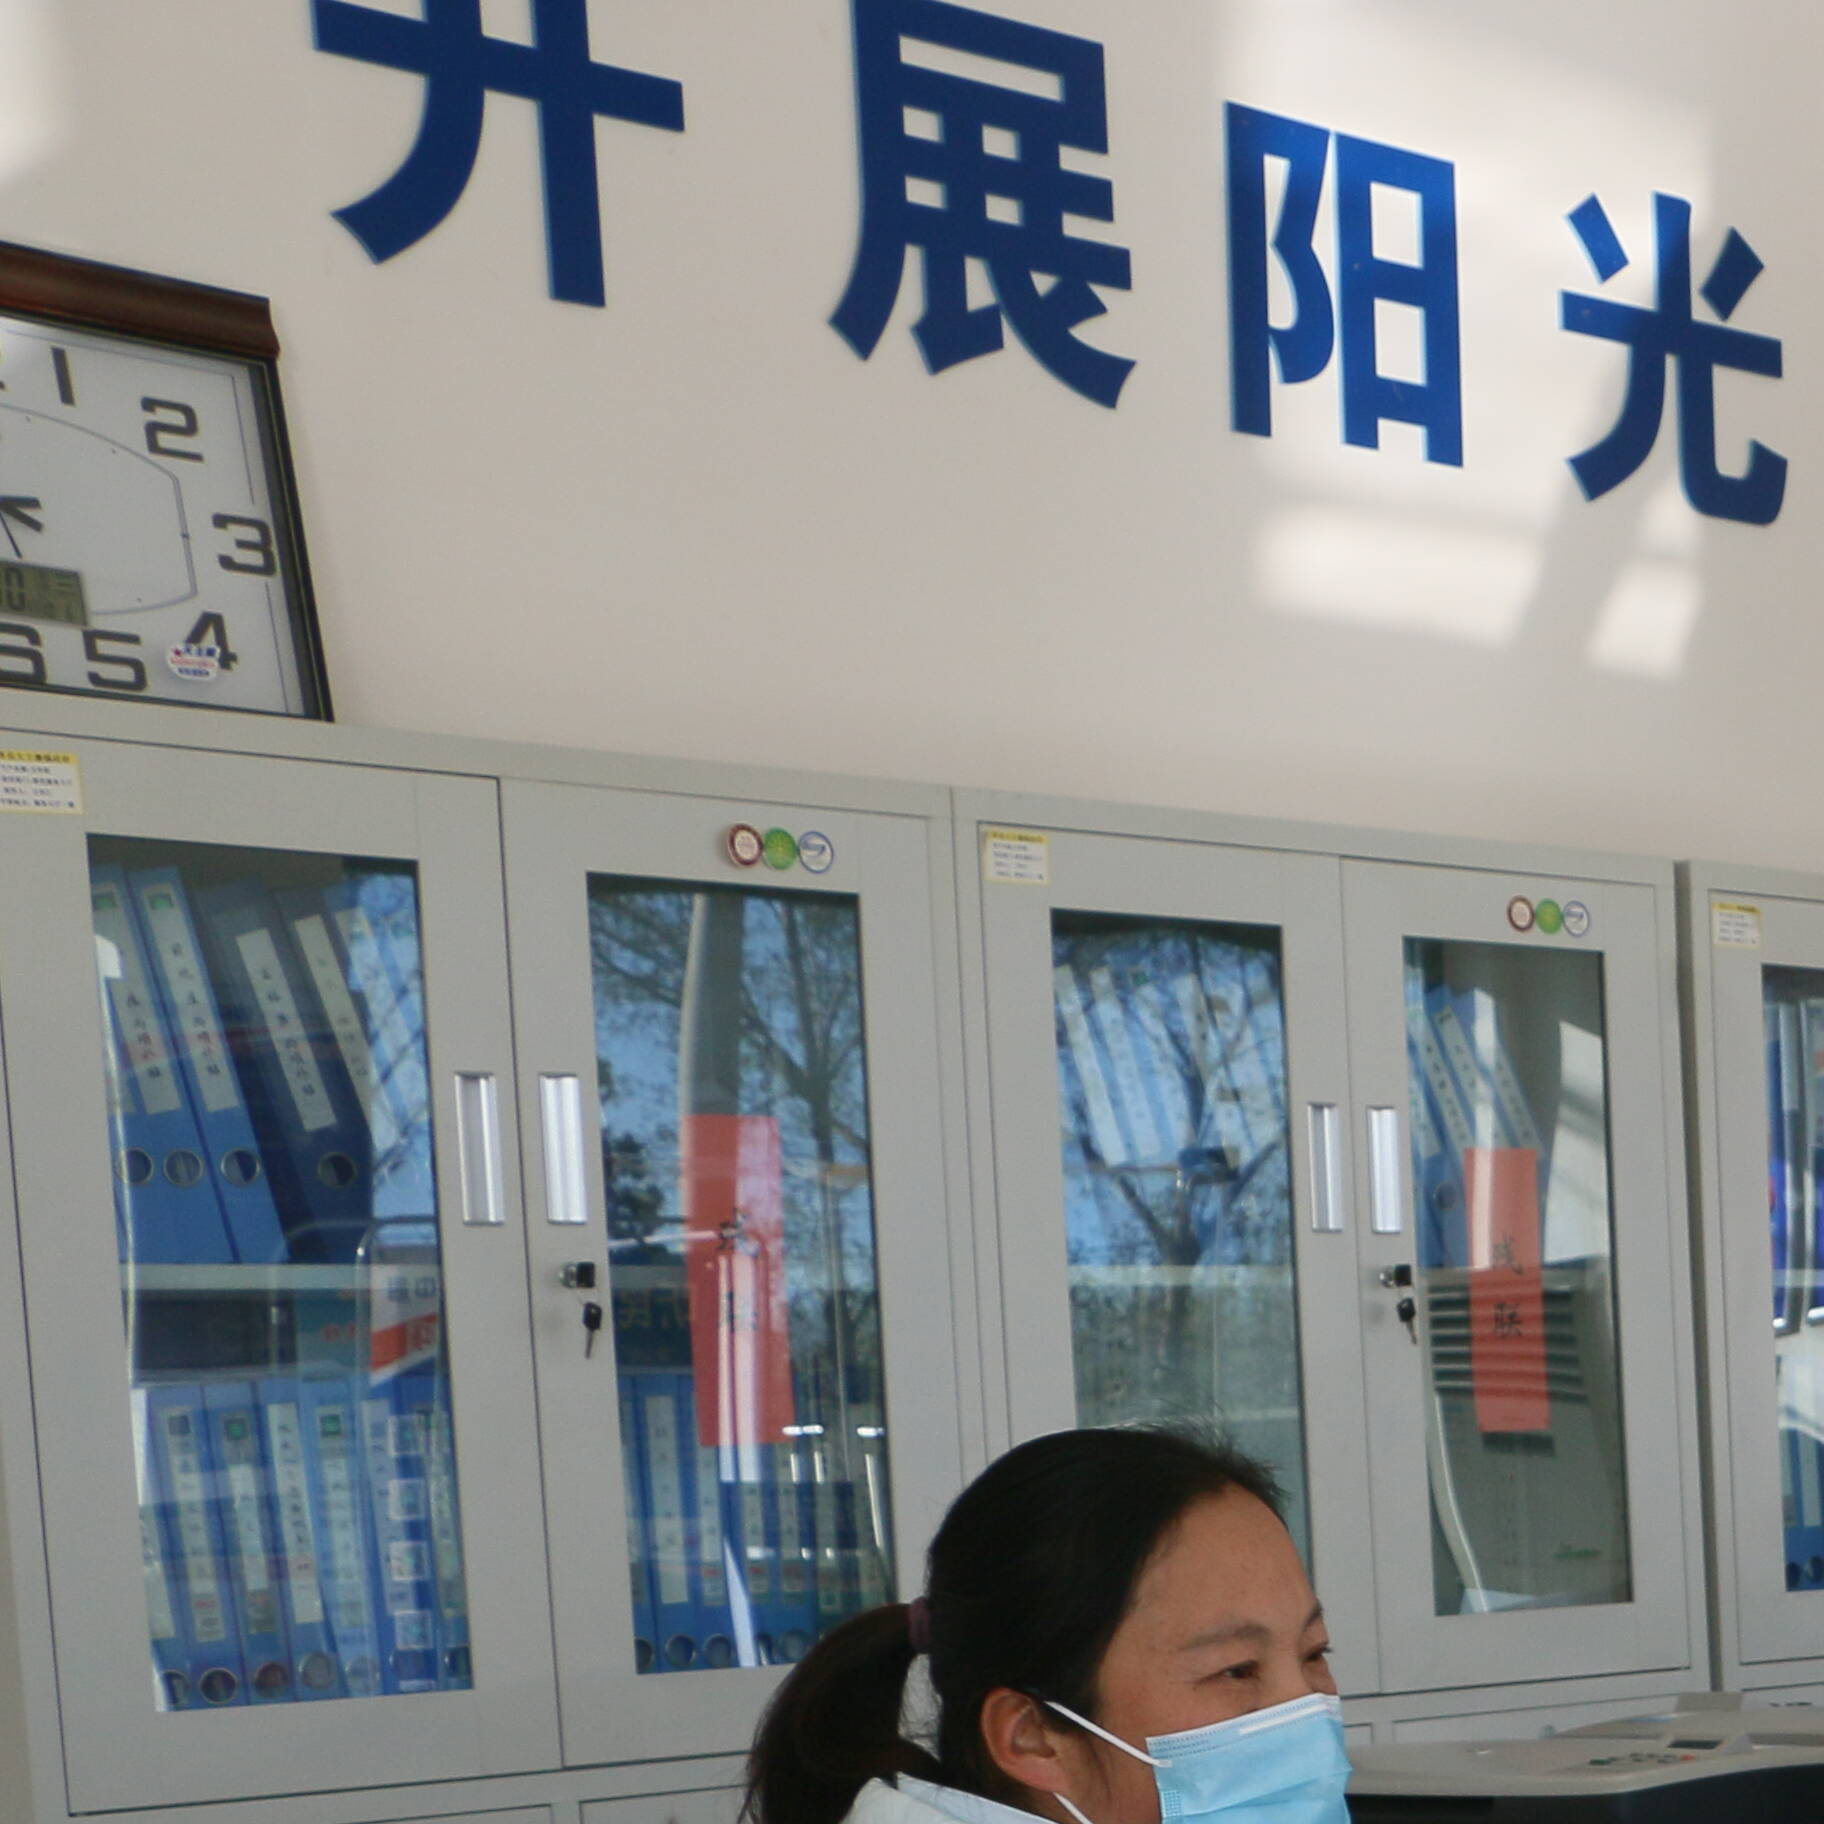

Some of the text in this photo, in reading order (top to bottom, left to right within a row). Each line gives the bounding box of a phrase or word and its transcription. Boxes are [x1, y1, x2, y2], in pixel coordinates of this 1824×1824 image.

[51, 346, 76, 407] 1
[140, 396, 204, 463] 2
[211, 512, 277, 577] 3
[82, 628, 147, 692] 5
